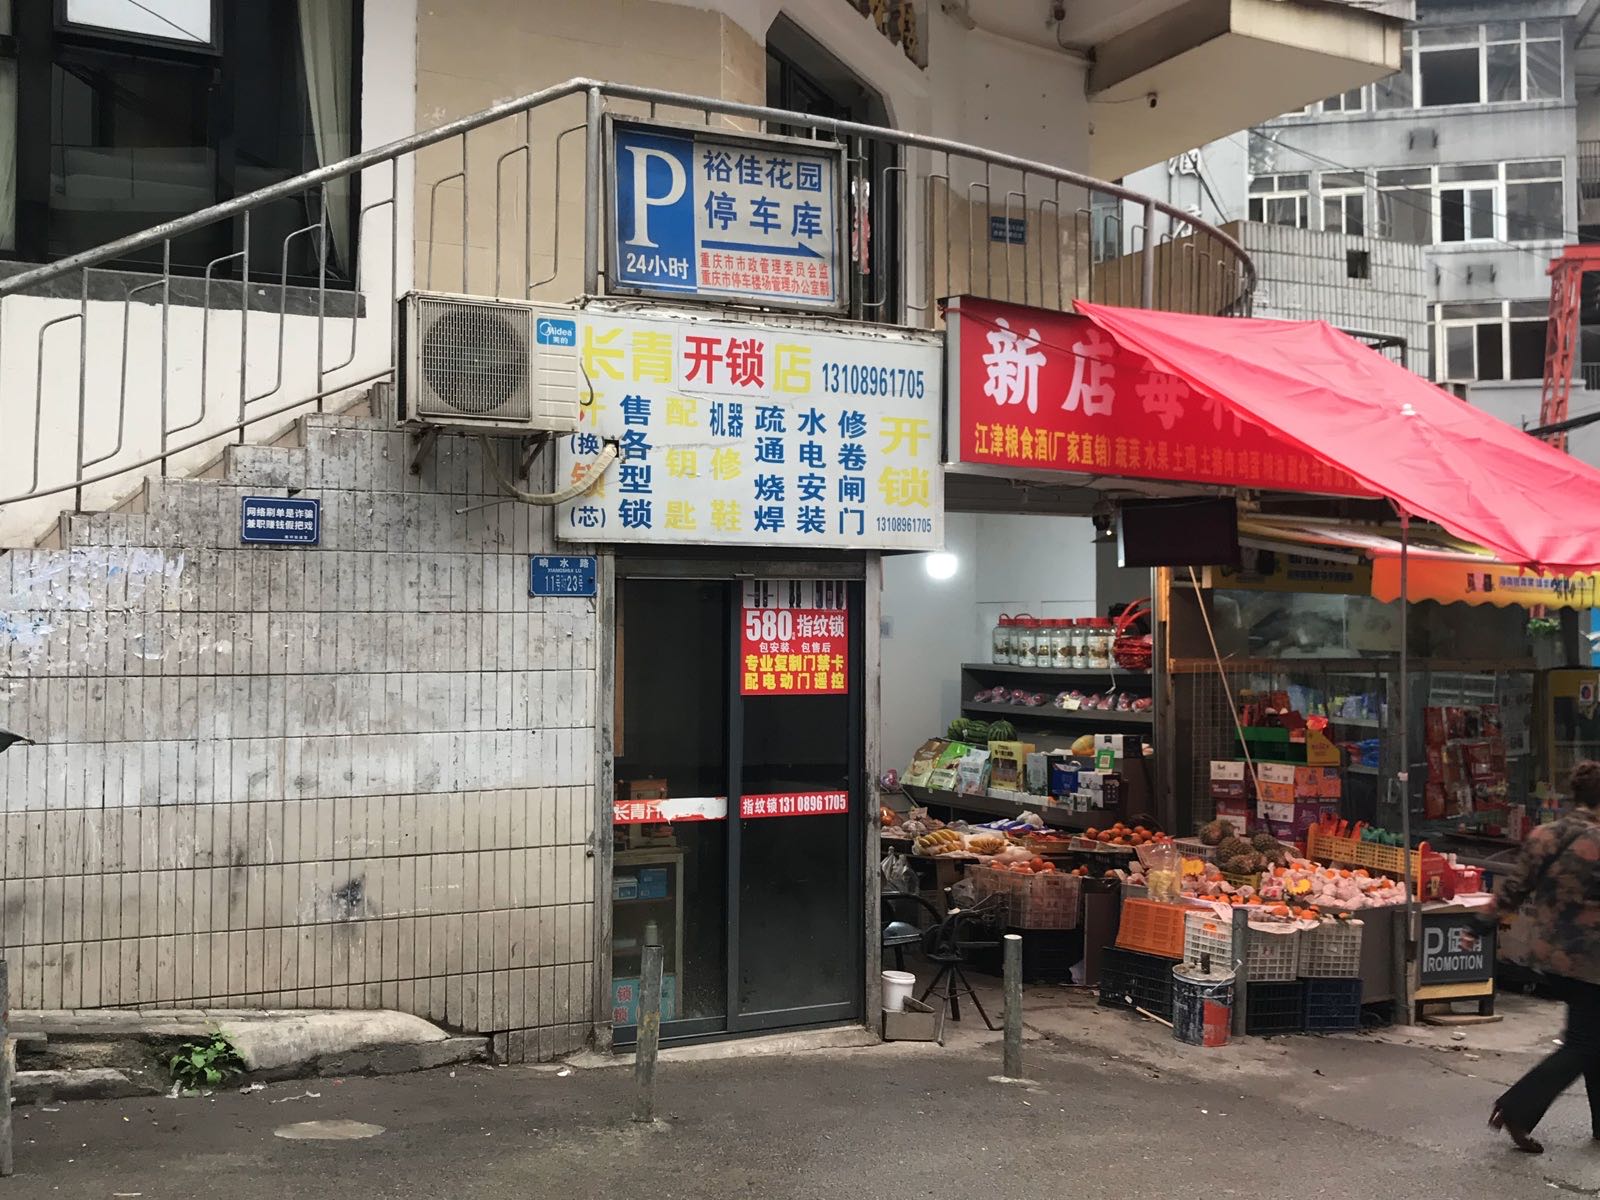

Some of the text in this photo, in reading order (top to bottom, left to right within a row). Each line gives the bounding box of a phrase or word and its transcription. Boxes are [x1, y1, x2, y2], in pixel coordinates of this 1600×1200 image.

[703, 150, 822, 193] 裕佳花园
[624, 146, 687, 248] P
[704, 190, 823, 239] 停车库
[626, 252, 689, 280] 24小时
[700, 252, 828, 279] 重庆市市政管理委员会监
[544, 326, 573, 337] Midea
[822, 363, 925, 400] 13108961705
[709, 401, 744, 438] 机器
[877, 416, 931, 509] 开锁
[876, 516, 932, 533] 13108961705
[539, 558, 589, 568] 响水路
[746, 610, 844, 642] 580 指纹锁
[745, 654, 844, 672] 专业复制门禁卡
